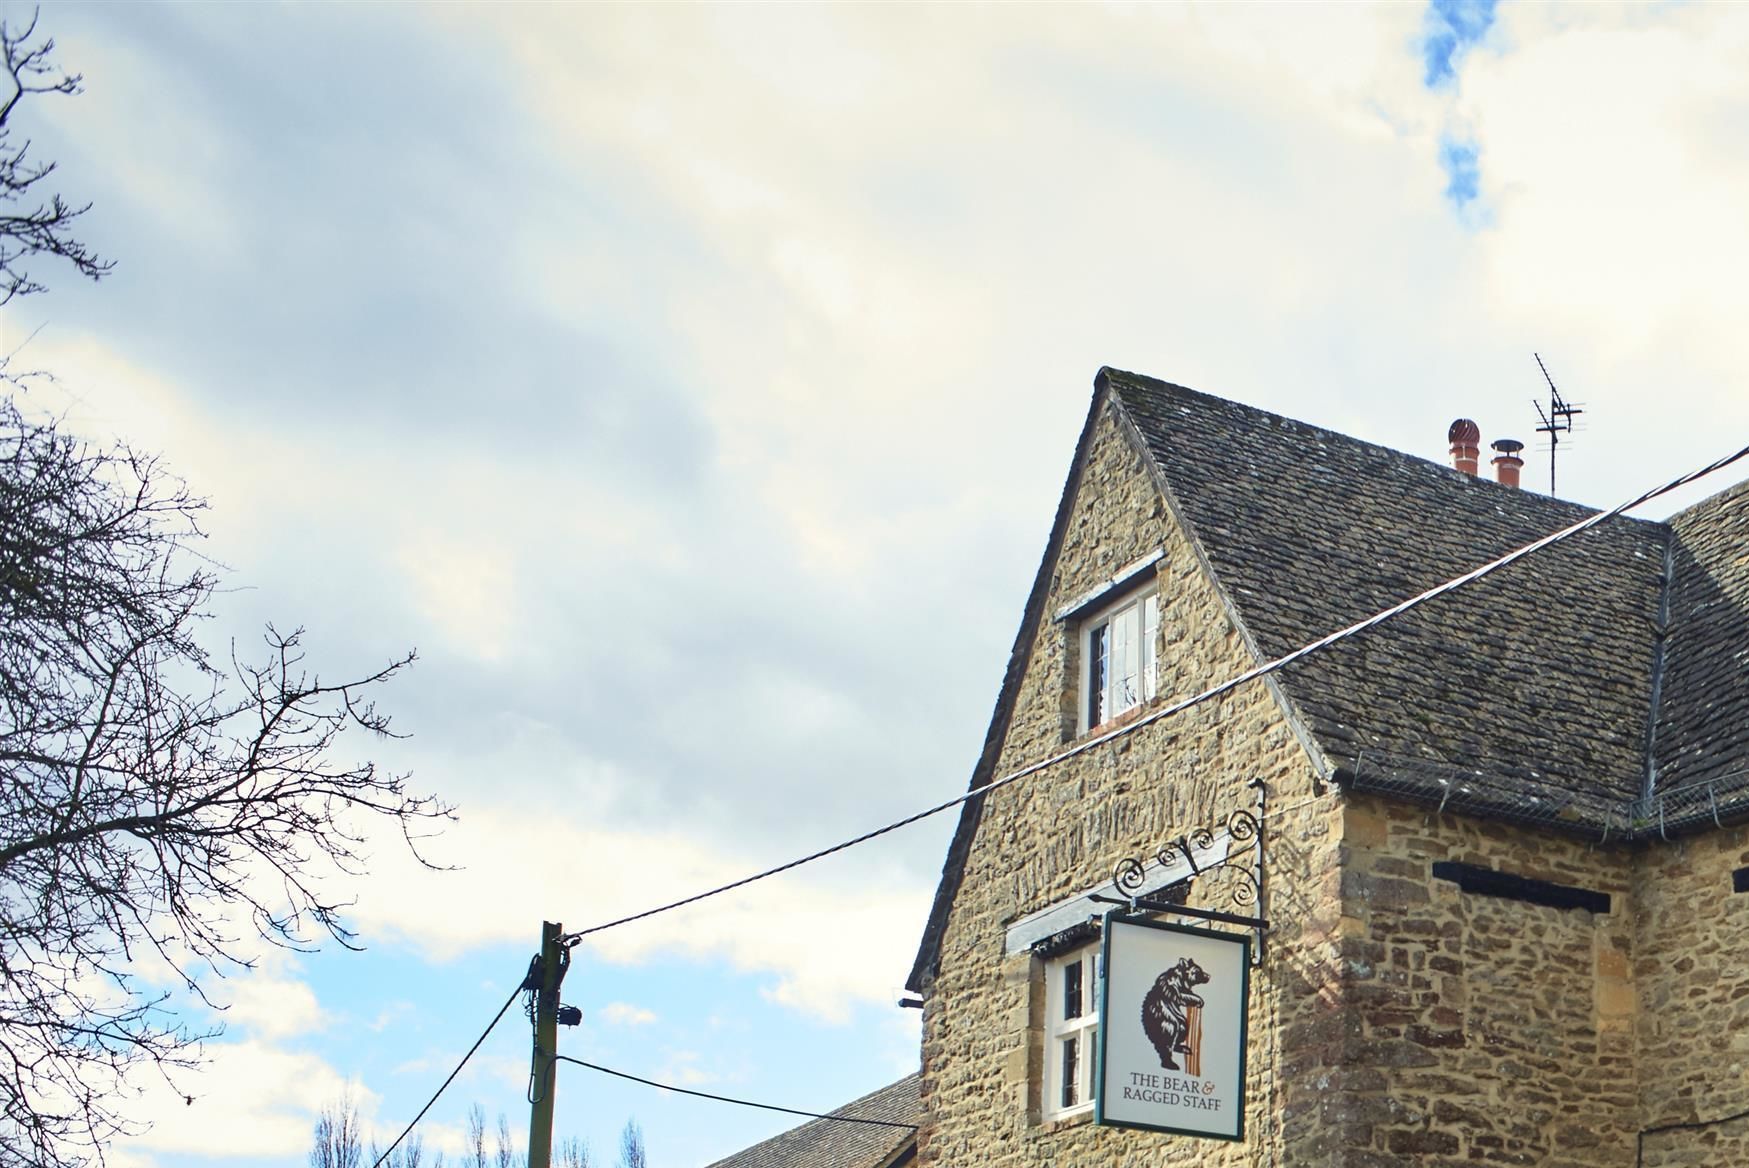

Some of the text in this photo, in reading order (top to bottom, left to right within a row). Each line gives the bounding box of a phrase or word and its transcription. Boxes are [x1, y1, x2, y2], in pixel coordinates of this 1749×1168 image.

[1130, 1072, 1216, 1095] THE BEAR &
[1123, 1087, 1222, 1111] RAGGED STAFF
